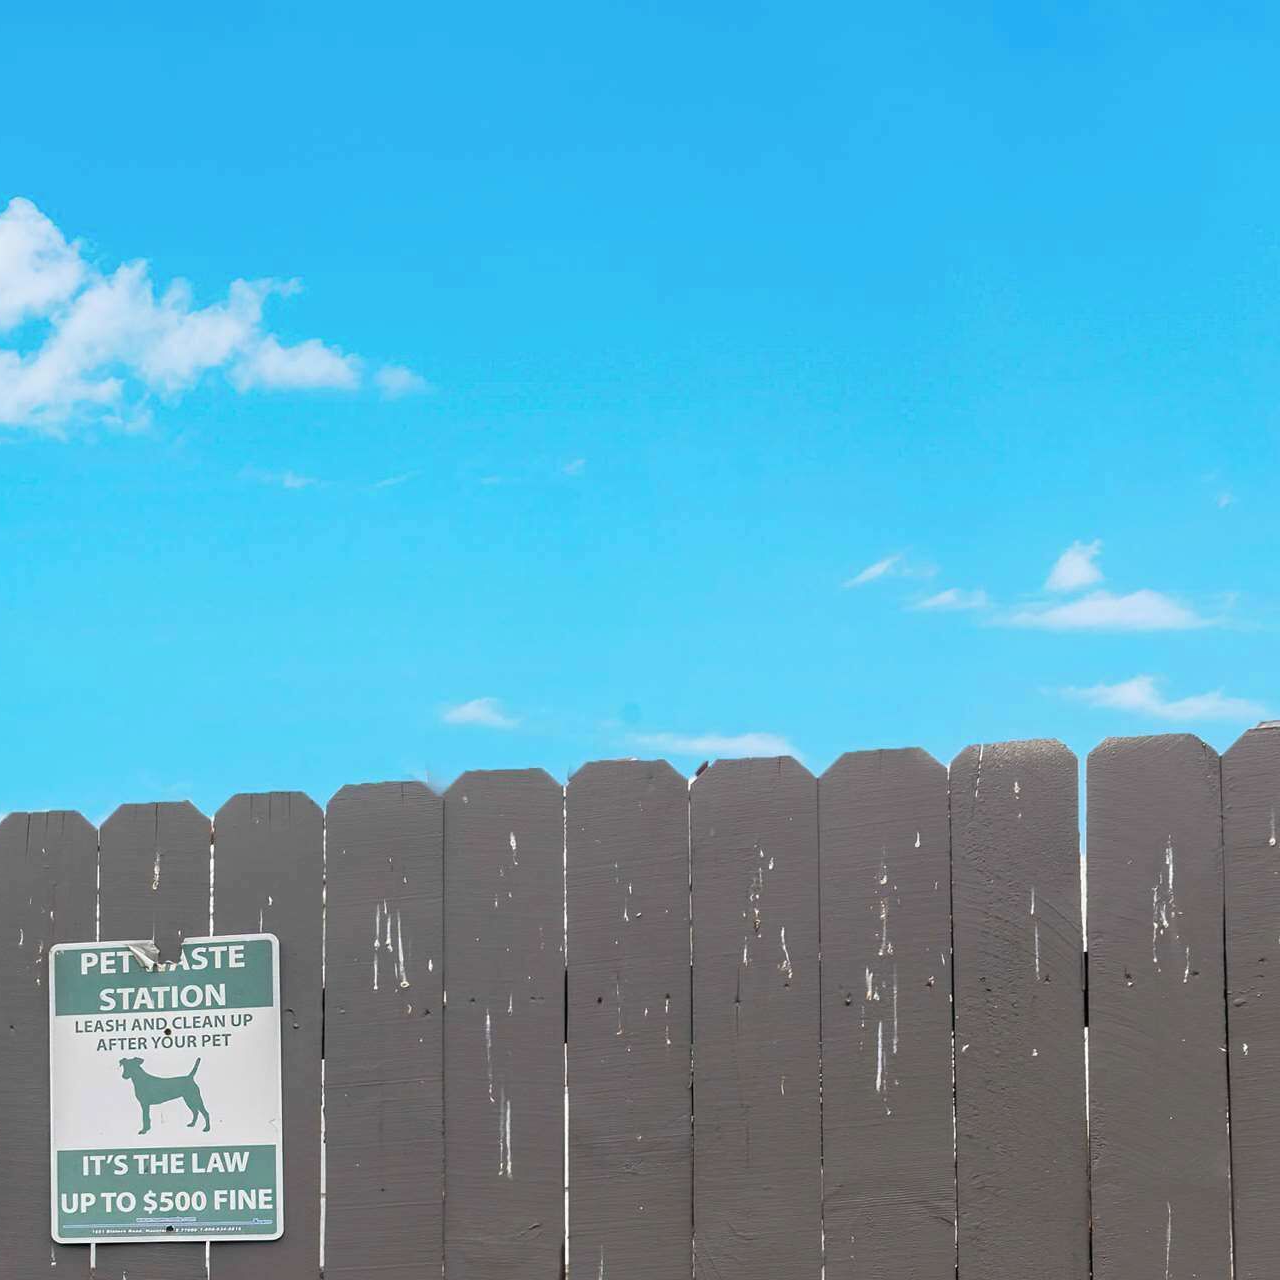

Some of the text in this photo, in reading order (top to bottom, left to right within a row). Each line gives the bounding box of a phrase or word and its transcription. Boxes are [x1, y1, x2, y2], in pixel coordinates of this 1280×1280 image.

[80, 945, 245, 975] PET ASTE
[99, 983, 226, 1011] STATION
[75, 1013, 253, 1033] LEASH AND CLEAN UP
[97, 1033, 231, 1051] AFTER YOUR PET
[82, 1151, 249, 1176] IT'S THE LAW
[60, 1188, 274, 1215] UP TO $500 FINE
